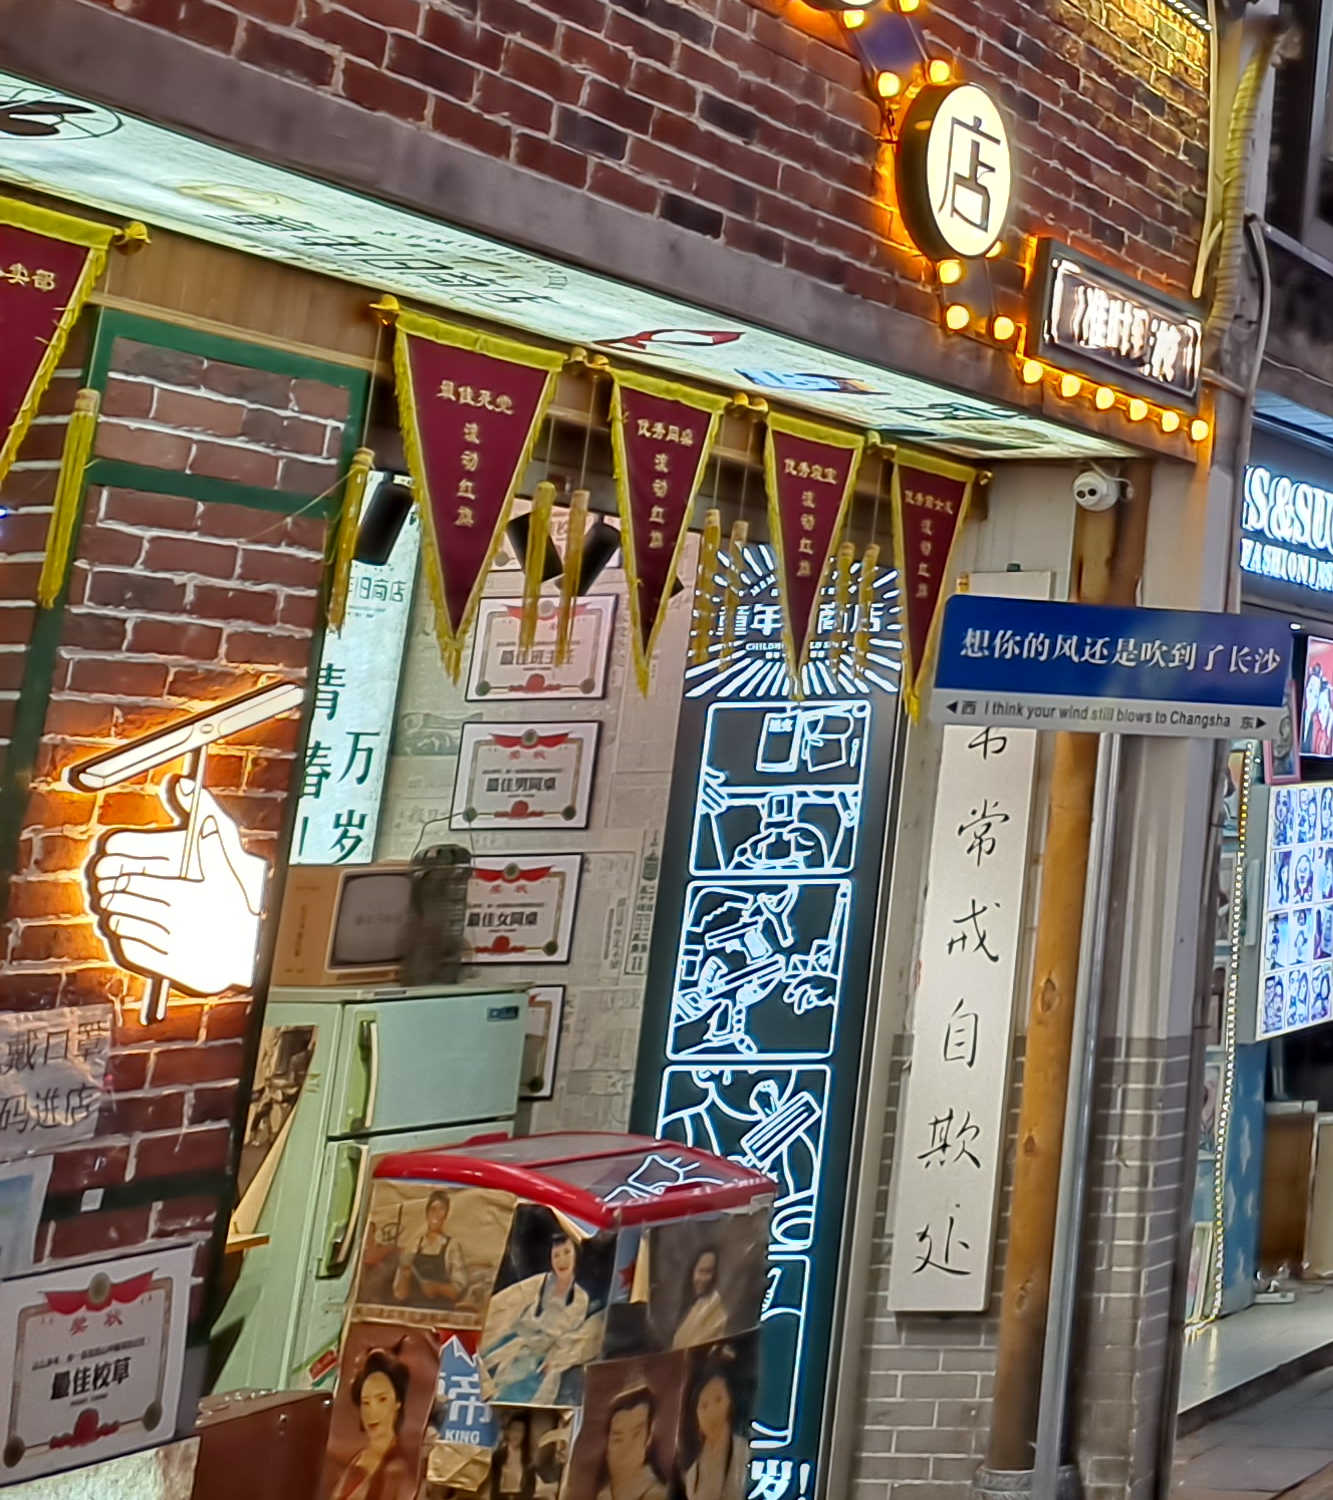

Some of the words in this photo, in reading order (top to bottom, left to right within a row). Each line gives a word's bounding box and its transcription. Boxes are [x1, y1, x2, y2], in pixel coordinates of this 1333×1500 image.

[0, 263, 56, 292] 卖部
[1240, 538, 1309, 586] FASHION
[347, 576, 406, 603] 旧商店
[960, 628, 1280, 675] 想你的风还是吹到了长沙
[961, 701, 978, 716] 西
[991, 702, 1024, 718] think
[1026, 705, 1056, 721] your
[1059, 704, 1088, 720] wind
[1090, 706, 1115, 722] still
[1117, 708, 1152, 724] blows
[1155, 711, 1168, 725] to
[1170, 711, 1231, 729] Changsha
[1240, 716, 1255, 730] 东
[51, 1356, 131, 1401] 最佳校草
[445, 1428, 480, 1444] KING
